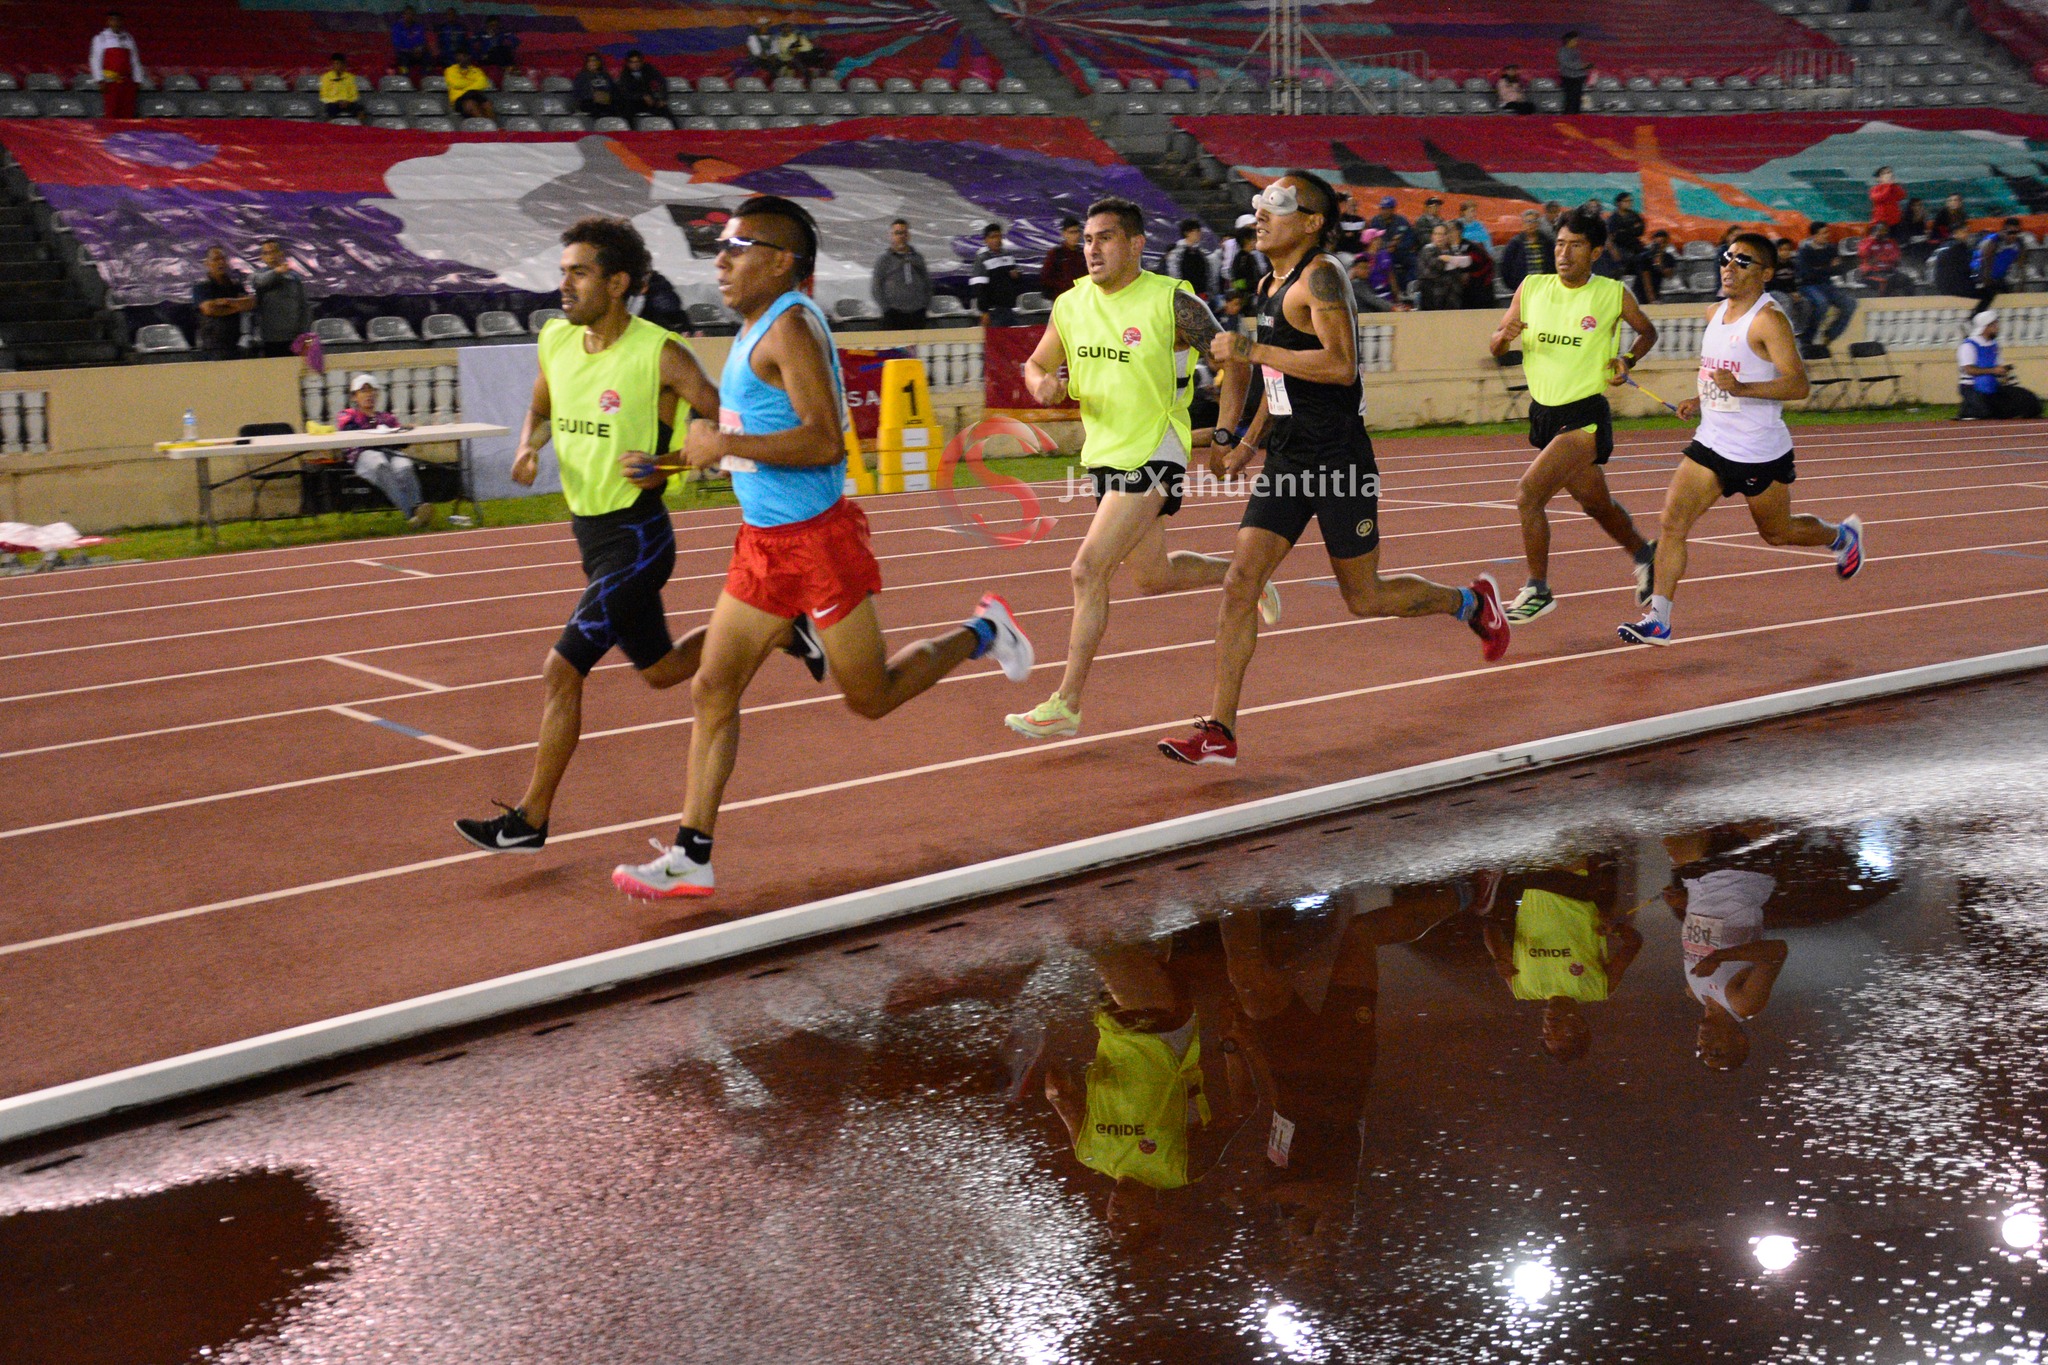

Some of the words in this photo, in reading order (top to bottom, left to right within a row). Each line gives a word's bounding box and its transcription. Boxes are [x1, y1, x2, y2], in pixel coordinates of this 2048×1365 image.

[1537, 332, 1583, 347] GUIDE
[1077, 345, 1130, 363] GUIDE
[902, 379, 917, 416] 1
[1702, 381, 1729, 402] 484
[558, 417, 610, 438] GUIDE
